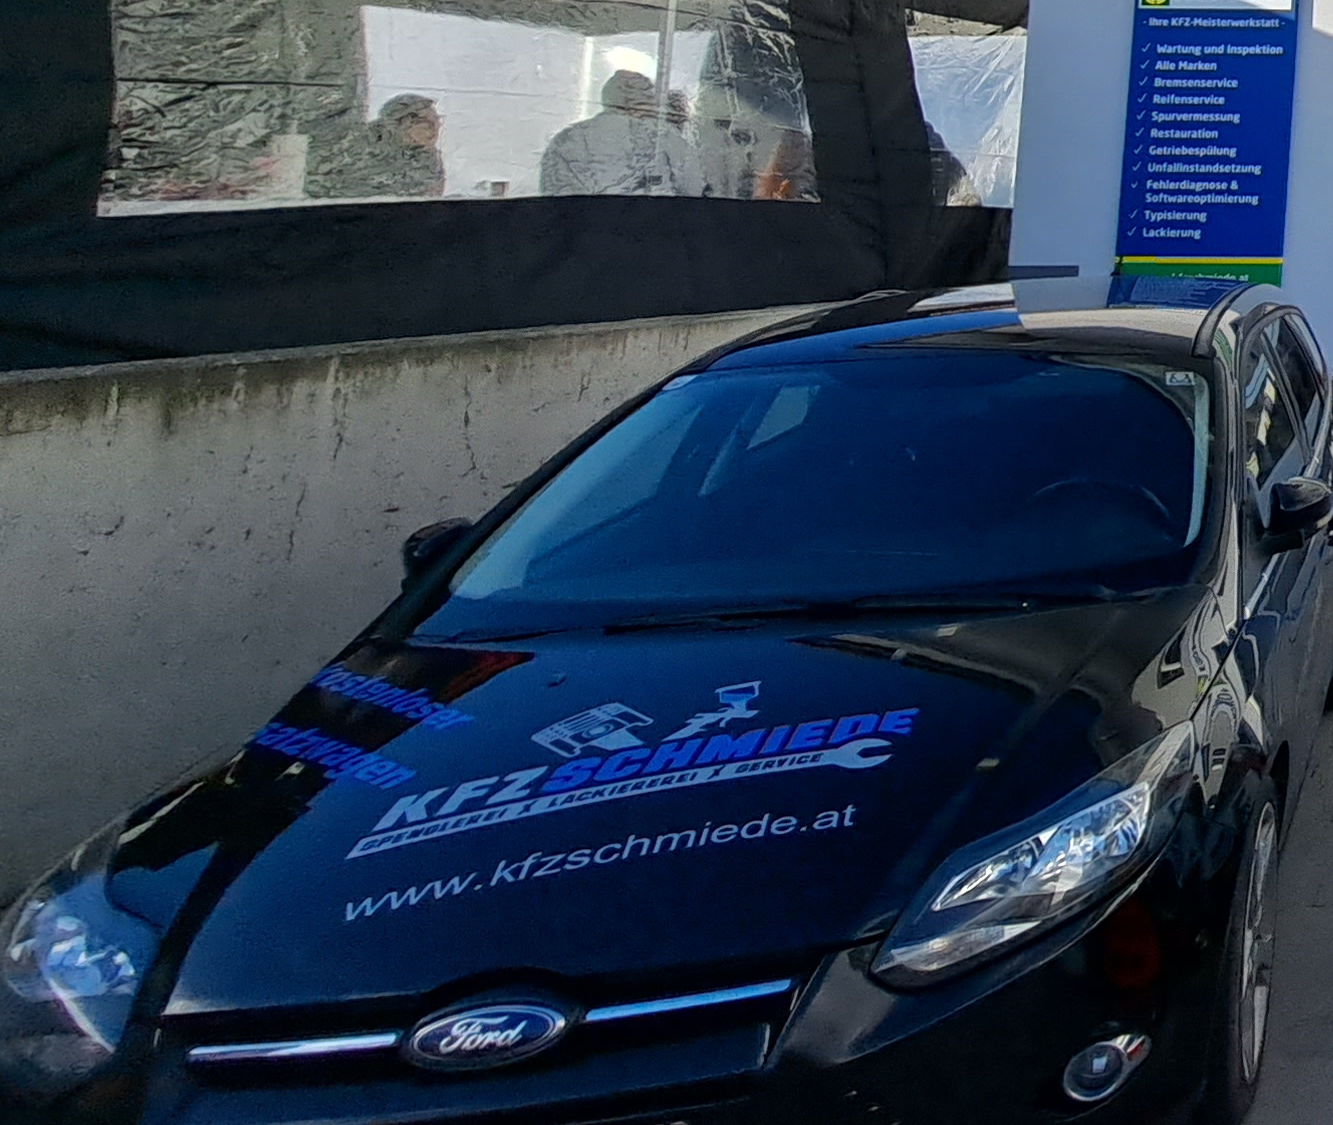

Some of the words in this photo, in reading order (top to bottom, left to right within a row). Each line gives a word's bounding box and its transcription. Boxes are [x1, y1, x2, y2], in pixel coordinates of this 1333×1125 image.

[1171, 17, 1280, 28] KFZ-Meisterwerkstatt
[1157, 44, 1201, 56] Wartung
[1204, 44, 1224, 54] und
[1227, 44, 1284, 56] Inspektion
[1155, 61, 1176, 70] Alle
[1178, 61, 1217, 70] Marken
[1154, 77, 1238, 88] Bremsenservice
[1153, 94, 1225, 105] Reifenservice
[1151, 111, 1240, 124] Spurvermessung
[1150, 128, 1218, 139] Restauration
[1149, 145, 1236, 158] Getriebespülung
[1148, 162, 1262, 175] Unfallinstandsetzung
[1147, 179, 1228, 193] Fehlerdiagnose
[1230, 180, 1238, 190] &
[1145, 193, 1259, 206] Softwareoptimierung
[1144, 210, 1207, 223] Typisierung
[1143, 227, 1201, 239] Lackierung
[345, 804, 857, 922] www.kfzschmiede.at
[439, 1015, 528, 1055] Ford
